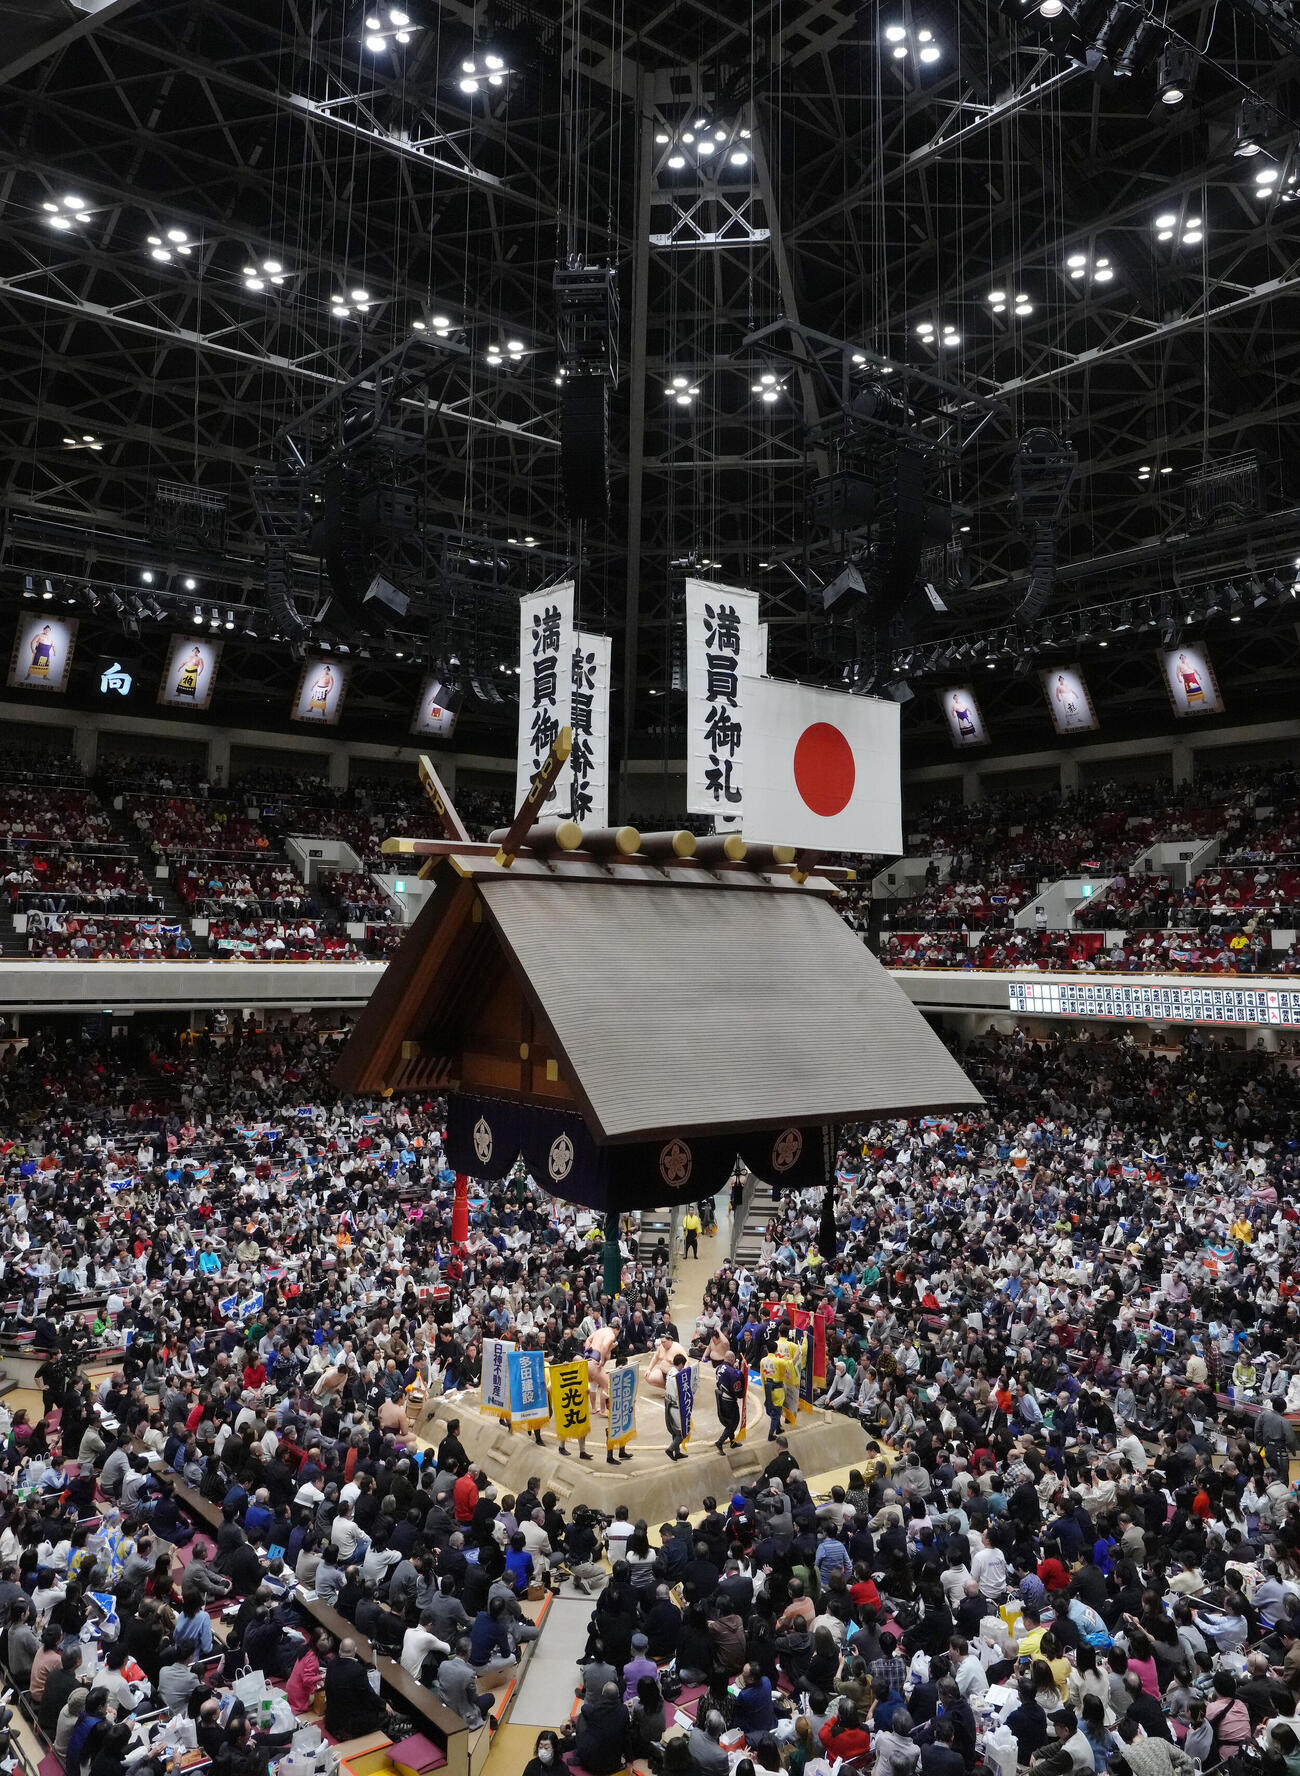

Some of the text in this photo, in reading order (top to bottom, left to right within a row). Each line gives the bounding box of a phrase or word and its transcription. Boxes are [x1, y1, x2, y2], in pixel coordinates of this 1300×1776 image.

[100, 662, 133, 696] 向
[703, 603, 742, 803] 満員御礼
[519, 1356, 535, 1405] 多田建設
[559, 1369, 587, 1429] 三光丸
